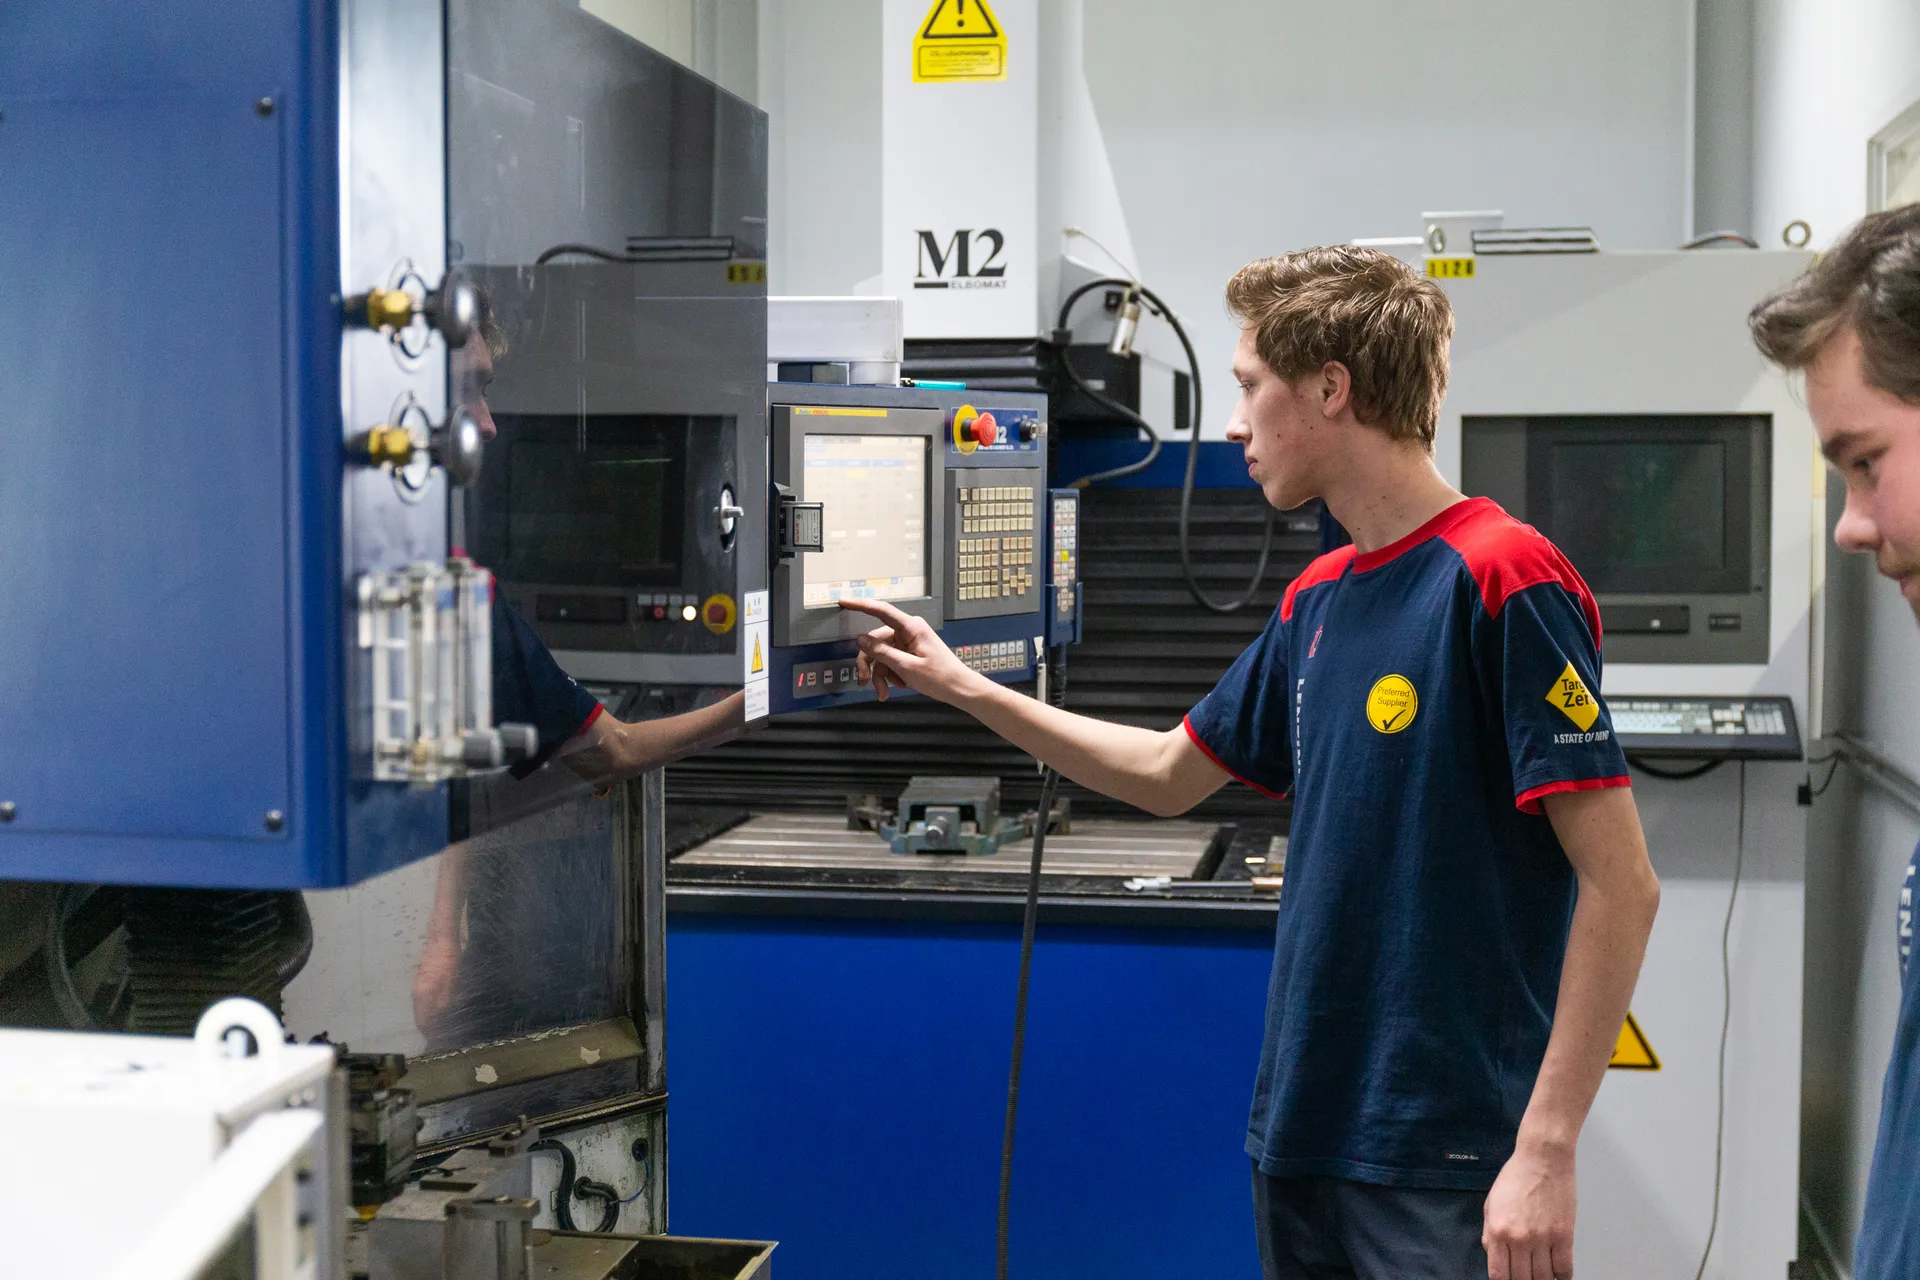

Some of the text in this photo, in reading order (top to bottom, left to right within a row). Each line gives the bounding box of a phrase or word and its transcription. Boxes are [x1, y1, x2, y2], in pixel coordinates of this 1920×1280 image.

[914, 228, 1007, 278] M2
[1377, 686, 1410, 698] Preferred
[1377, 696, 1408, 708] Supplier
[1560, 733, 1584, 744] STATE
